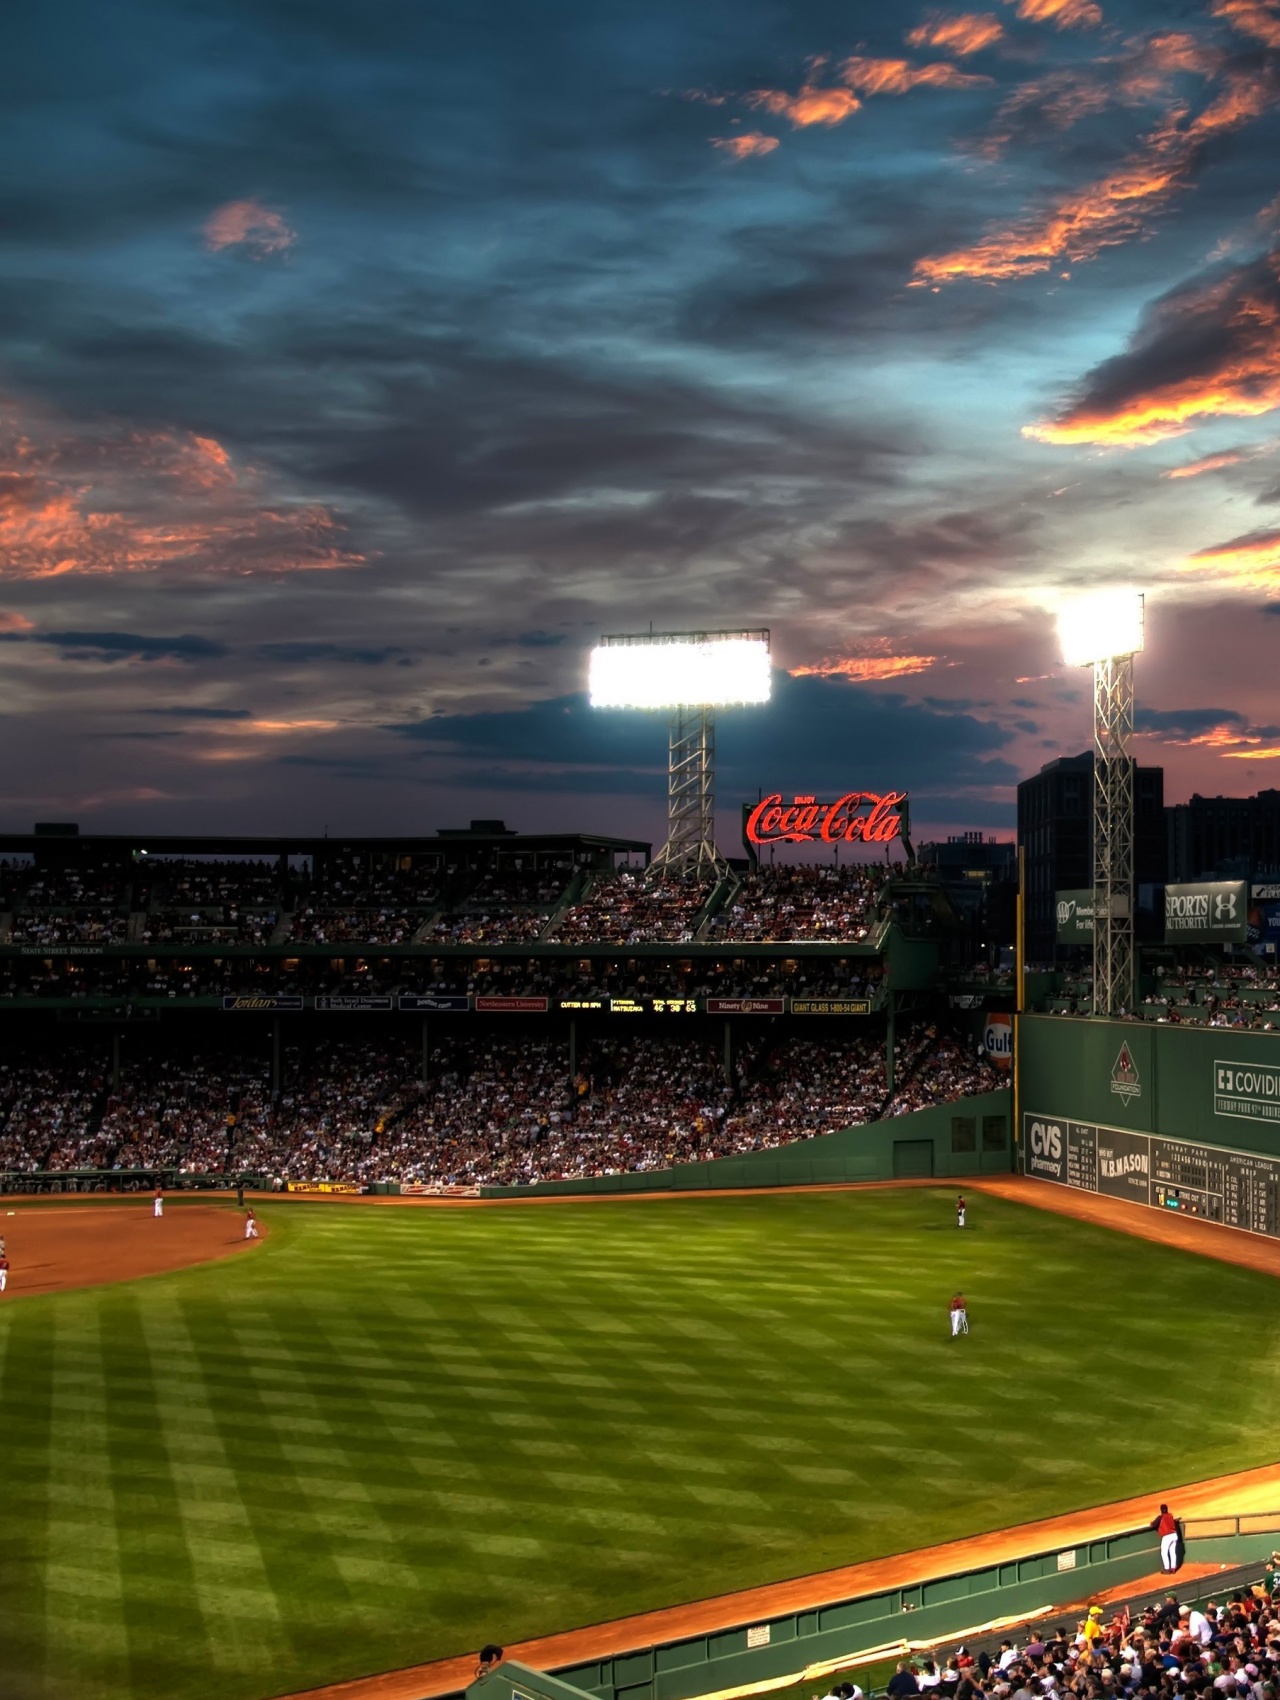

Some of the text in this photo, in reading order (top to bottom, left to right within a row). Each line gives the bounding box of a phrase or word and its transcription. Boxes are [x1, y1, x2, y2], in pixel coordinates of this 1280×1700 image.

[795, 796, 815, 804] ENJOY
[746, 791, 908, 844] Coca-Cola
[1166, 895, 1208, 917] SPORTS
[1076, 919, 1084, 929] For
[232, 997, 278, 1009] Jordan's
[516, 1000, 545, 1008] University
[719, 1002, 740, 1010] Ninety
[794, 1003, 810, 1012] GIANT
[810, 1003, 828, 1012] GLASS
[850, 1003, 867, 1012] GIANT
[1112, 1084, 1140, 1093] FOUNDATION
[1218, 1100, 1237, 1112] FENWAY
[1238, 1102, 1251, 1114] PARK
[1030, 1122, 1062, 1159] CVS
[1162, 1142, 1208, 1158] FENWAY PARK
[1031, 1156, 1061, 1178] pharmacy
[1100, 1154, 1148, 1178] W.B.MASON
[1230, 1156, 1273, 1170] AMERICAN LEAGUE
[1128, 1178, 1138, 1186] SINCE
